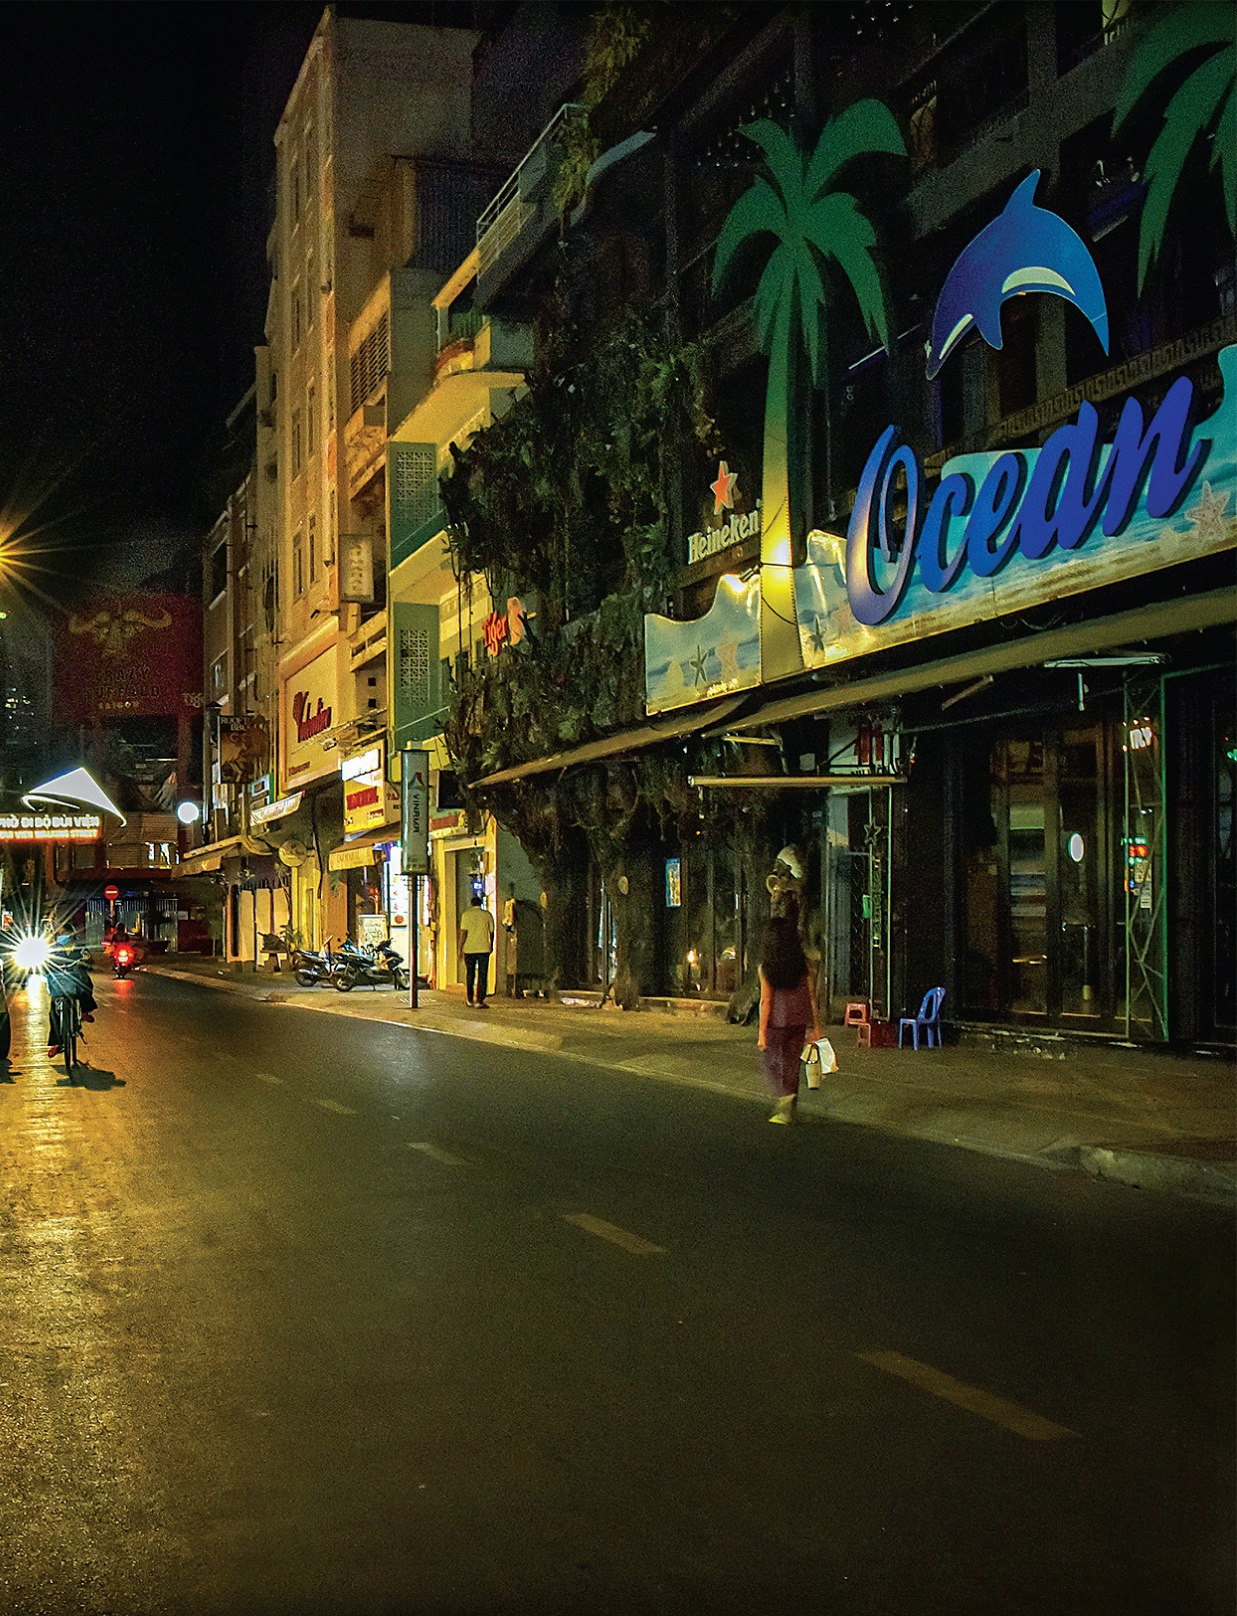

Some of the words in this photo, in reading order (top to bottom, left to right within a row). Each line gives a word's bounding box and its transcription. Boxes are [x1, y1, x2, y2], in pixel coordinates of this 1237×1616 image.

[846, 375, 1212, 627] Ocean
[688, 510, 760, 565] Heineken
[482, 611, 508, 657] Tiger
